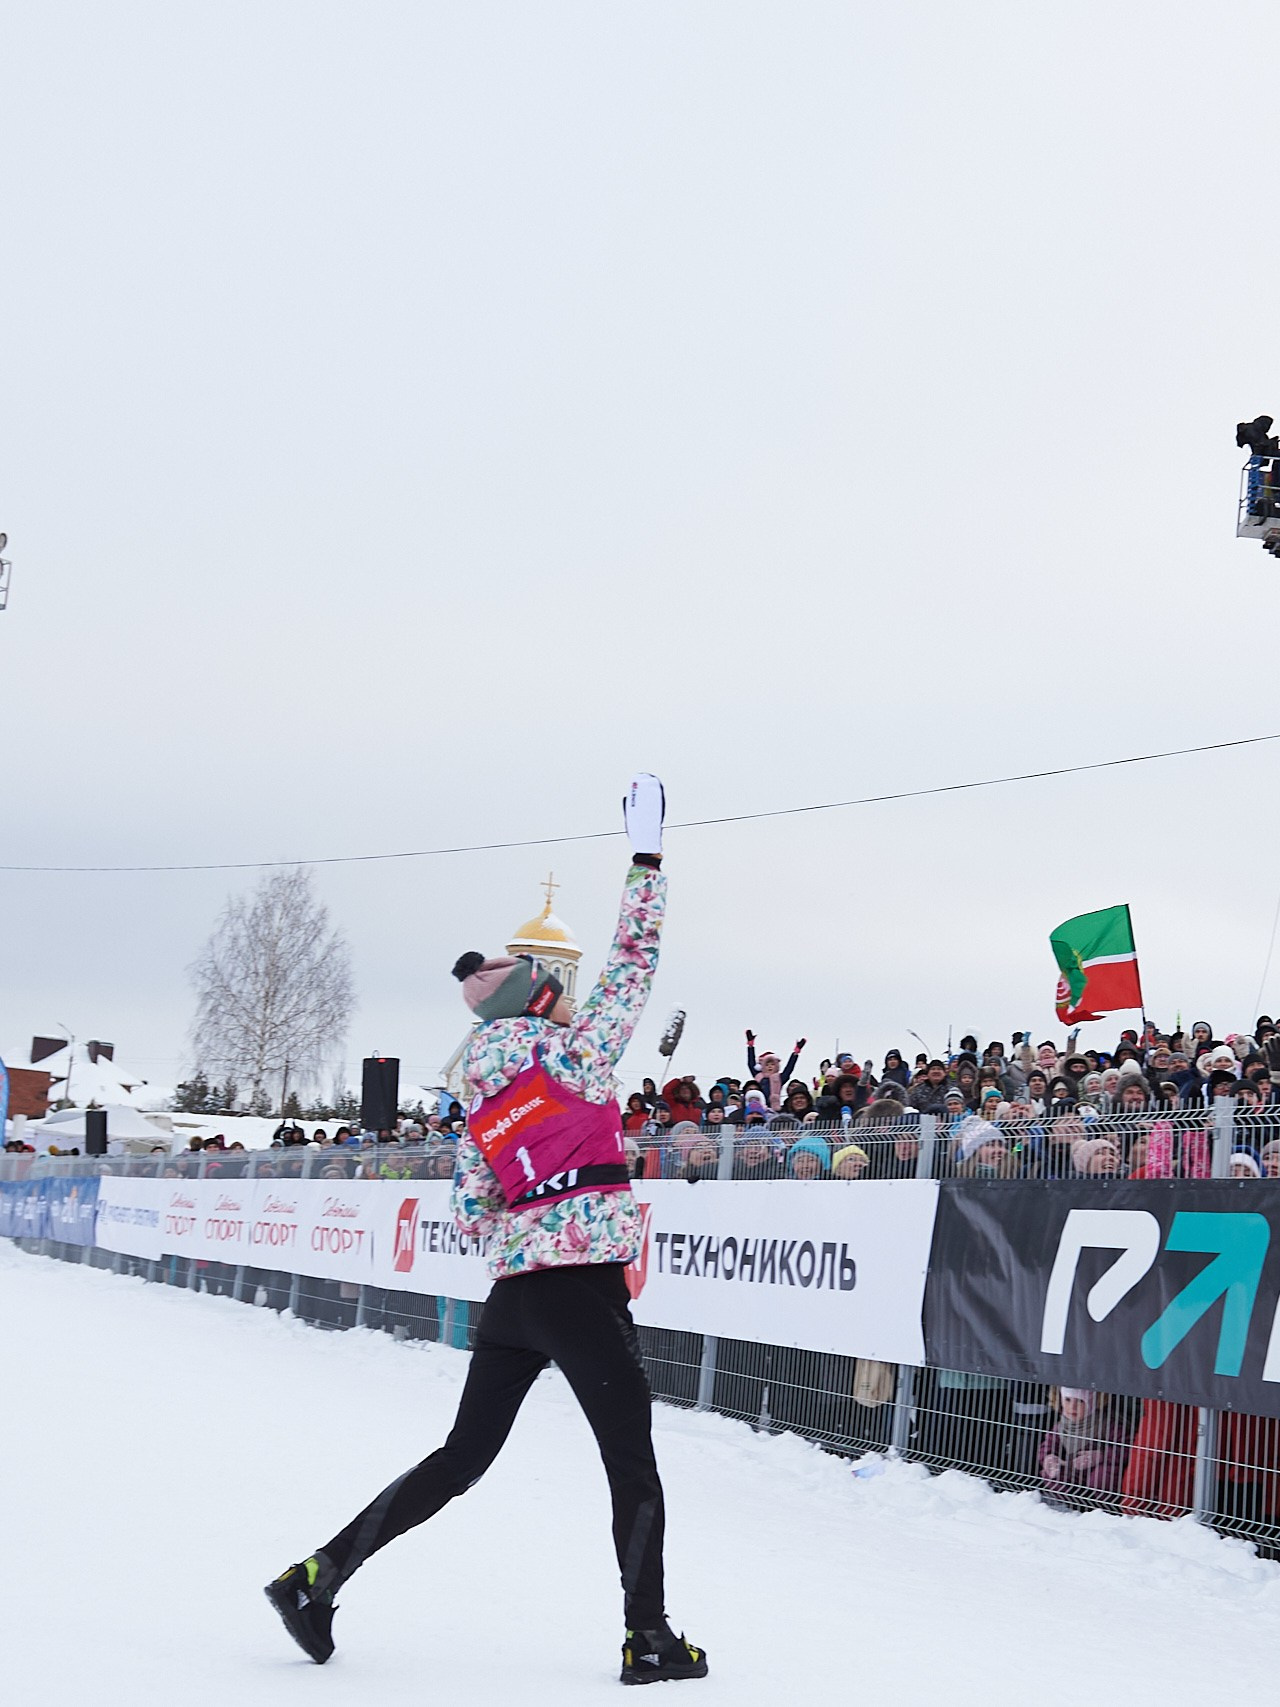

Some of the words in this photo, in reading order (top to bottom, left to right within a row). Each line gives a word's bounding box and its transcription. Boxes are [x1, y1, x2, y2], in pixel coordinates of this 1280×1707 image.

[515, 1146, 537, 1181] 1
[311, 1225, 365, 1256] СПОРТ
[654, 1231, 858, 1292] ТЕХНОНИКОЛЬ
